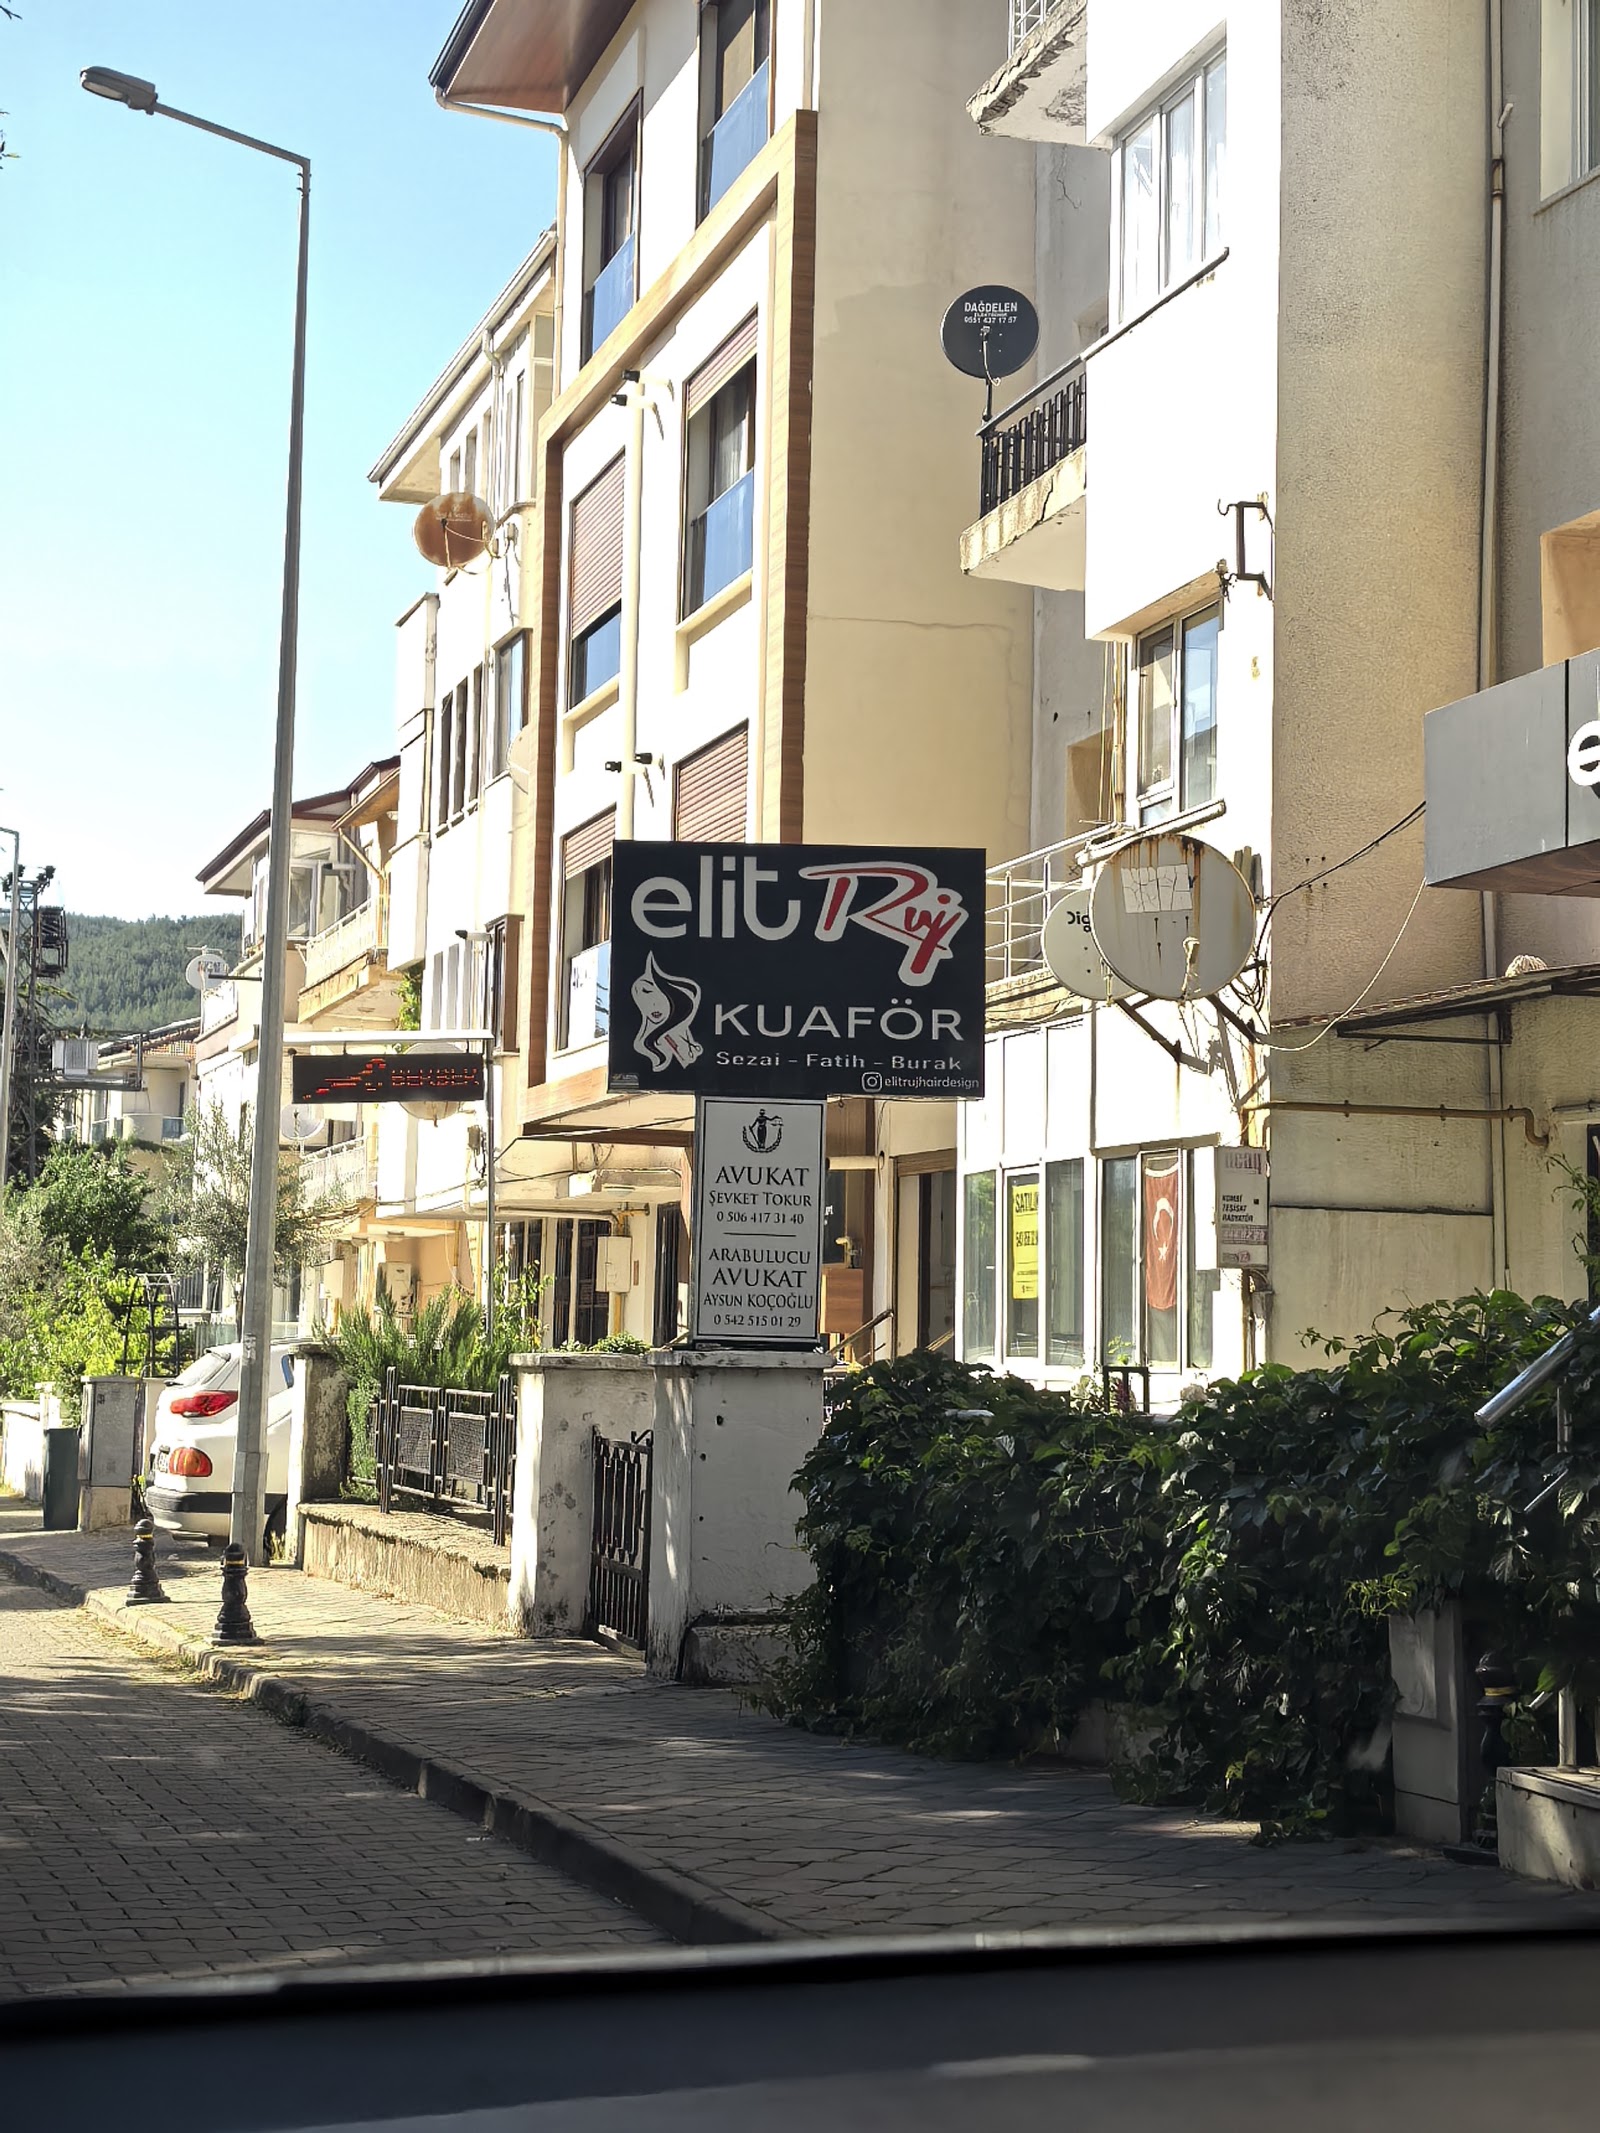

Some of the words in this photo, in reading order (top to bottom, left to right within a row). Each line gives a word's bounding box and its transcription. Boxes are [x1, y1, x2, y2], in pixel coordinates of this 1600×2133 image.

[964, 300, 1017, 312] DAĞDELEN
[631, 855, 800, 941] elit
[798, 861, 970, 986] Ruj
[714, 998, 964, 1041] KUAFÖR
[716, 1051, 780, 1066] Sezai
[806, 1053, 865, 1069] Fatih
[892, 1055, 962, 1071] Burak
[884, 1075, 980, 1090] elitrujhairdesign
[715, 1166, 810, 1187] AVUKAT
[708, 1190, 759, 1207] ŞEVKET
[762, 1192, 812, 1207] TOKUR
[716, 1211, 724, 1222] 0
[727, 1211, 748, 1223] 506
[773, 1213, 786, 1224] 31
[790, 1213, 805, 1225] 40
[708, 1248, 811, 1265] ARABULUCU
[711, 1267, 808, 1288] AVUKAT
[703, 1292, 743, 1307] AYSUN
[747, 1292, 814, 1311] KOÇOĞLU
[713, 1314, 722, 1326] 0
[724, 1314, 745, 1326] 542
[747, 1315, 768, 1327] 515
[770, 1315, 783, 1327] 01
[786, 1316, 802, 1328] 29
